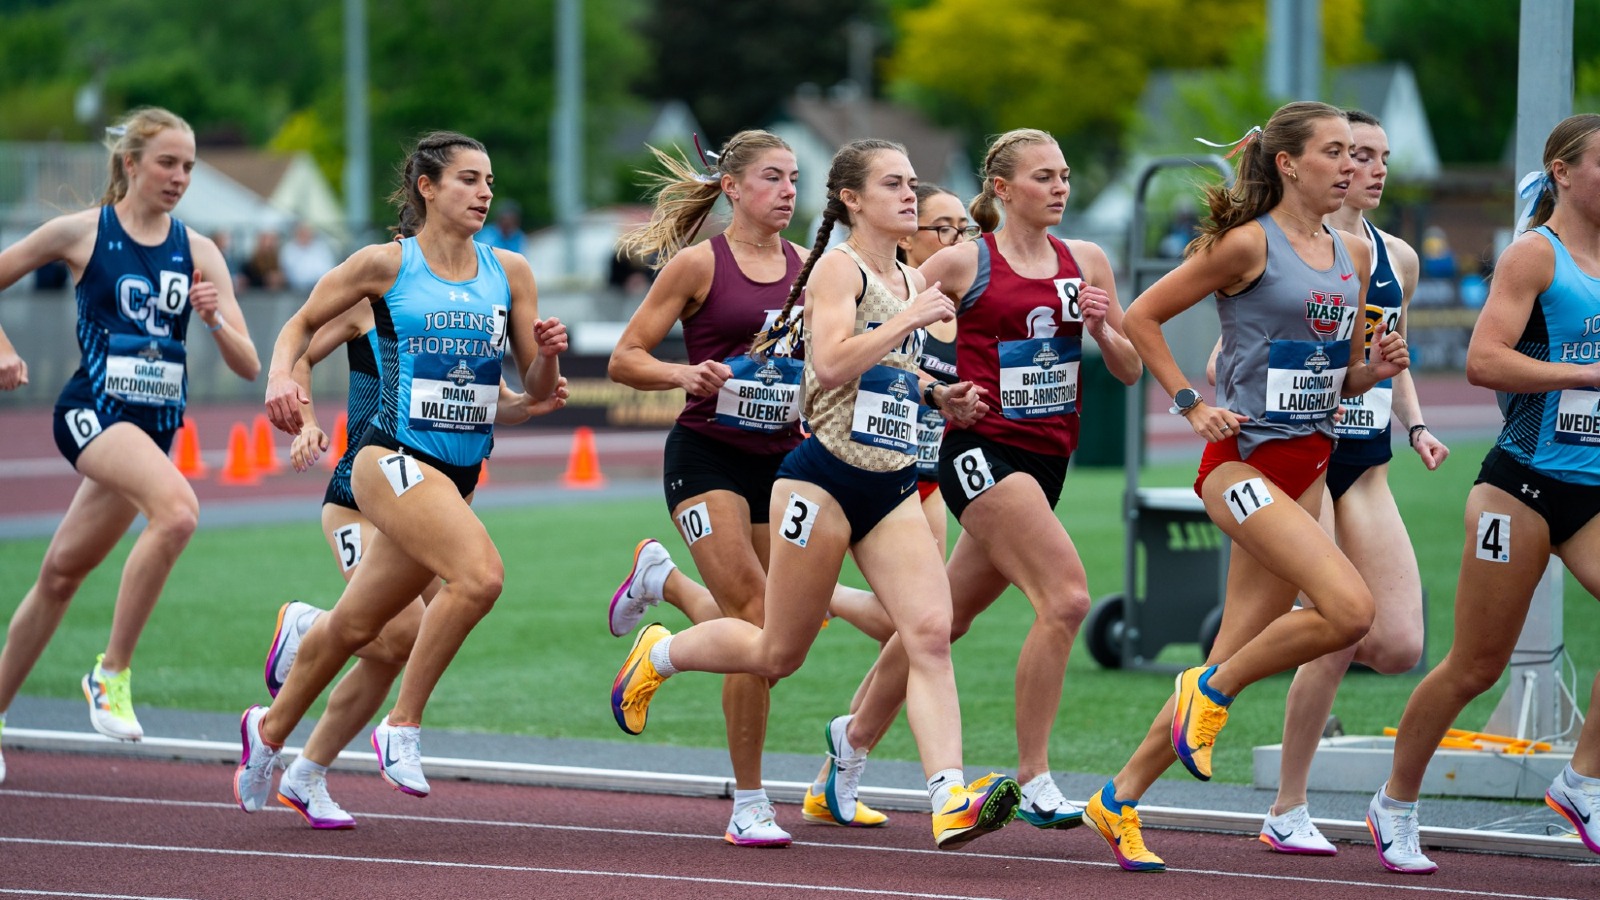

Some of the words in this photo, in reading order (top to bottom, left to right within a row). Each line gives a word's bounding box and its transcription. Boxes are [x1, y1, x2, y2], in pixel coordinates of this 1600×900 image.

[166, 278, 182, 310] 6
[1064, 282, 1081, 319] 8
[425, 310, 495, 334] JOHNS
[498, 310, 507, 346] 7
[408, 337, 500, 359] HOPKIN
[134, 364, 166, 378] GRACE
[1022, 369, 1067, 386] BAYLEIGH
[1293, 376, 1333, 390] LUCINDA
[107, 376, 180, 398] MCDONOUGH
[442, 387, 475, 402] DIANA
[739, 386, 795, 403] BROOKLYN
[1002, 383, 1076, 407] REDD-ARMSTRONG
[421, 402, 488, 422] VALENTINI
[737, 401, 790, 422] LUEBKE
[882, 401, 910, 419] BAILEY
[1279, 392, 1336, 411] LAUGHLIN
[74, 409, 92, 438] 6
[1559, 413, 1600, 434] WEDE
[386, 456, 409, 489] 7
[961, 455, 985, 491] 8
[1230, 482, 1261, 517] 11
[682, 510, 702, 542] 10
[784, 501, 808, 540] 3
[340, 529, 356, 567] 5
[1482, 518, 1503, 559] 4
